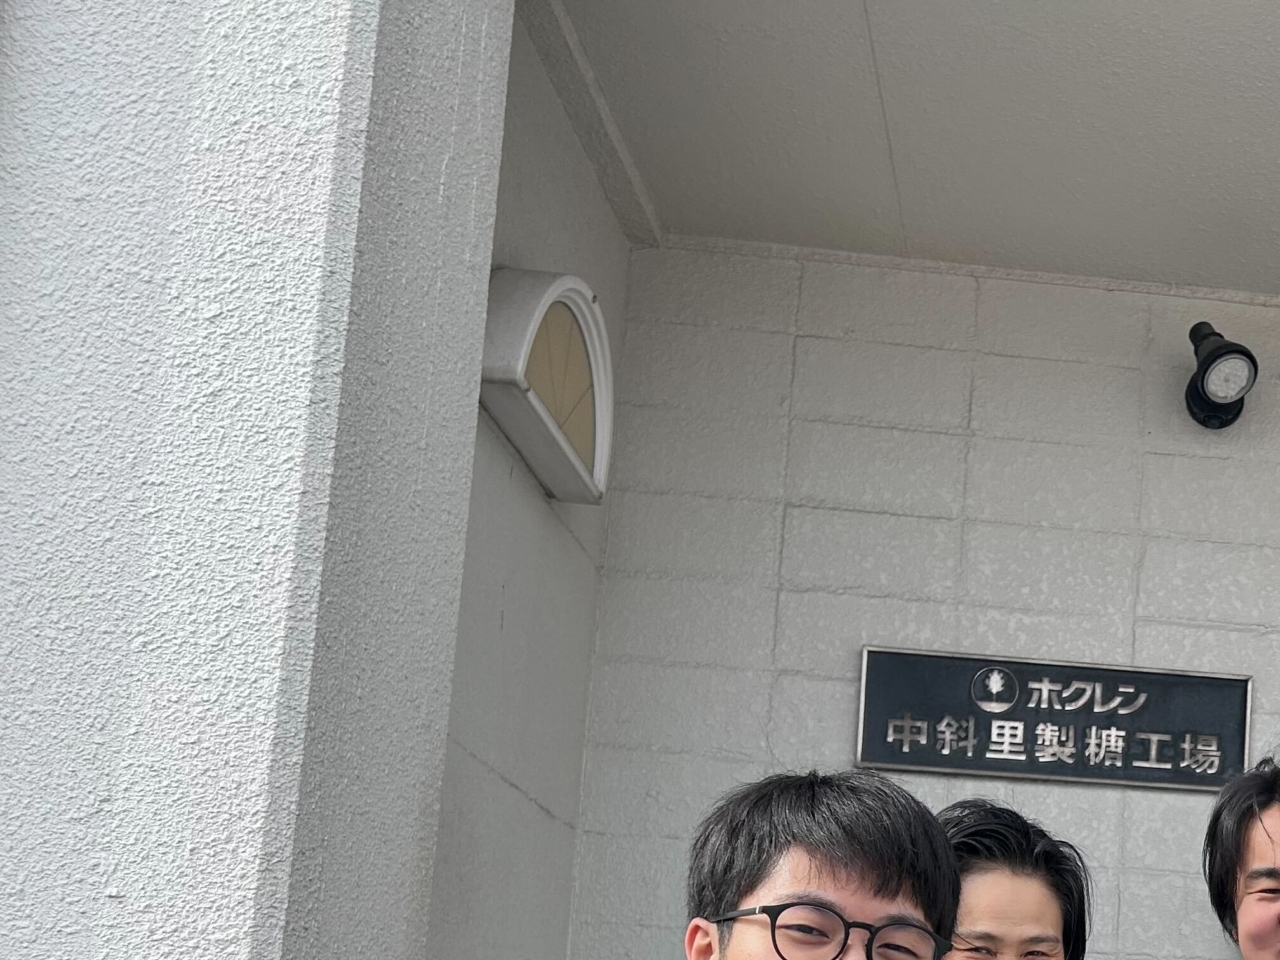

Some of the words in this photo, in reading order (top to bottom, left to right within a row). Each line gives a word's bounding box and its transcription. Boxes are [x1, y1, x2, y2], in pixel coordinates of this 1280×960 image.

[1026, 676, 1148, 715] ホクレン
[886, 711, 1222, 775] 中斜里製糖工場
